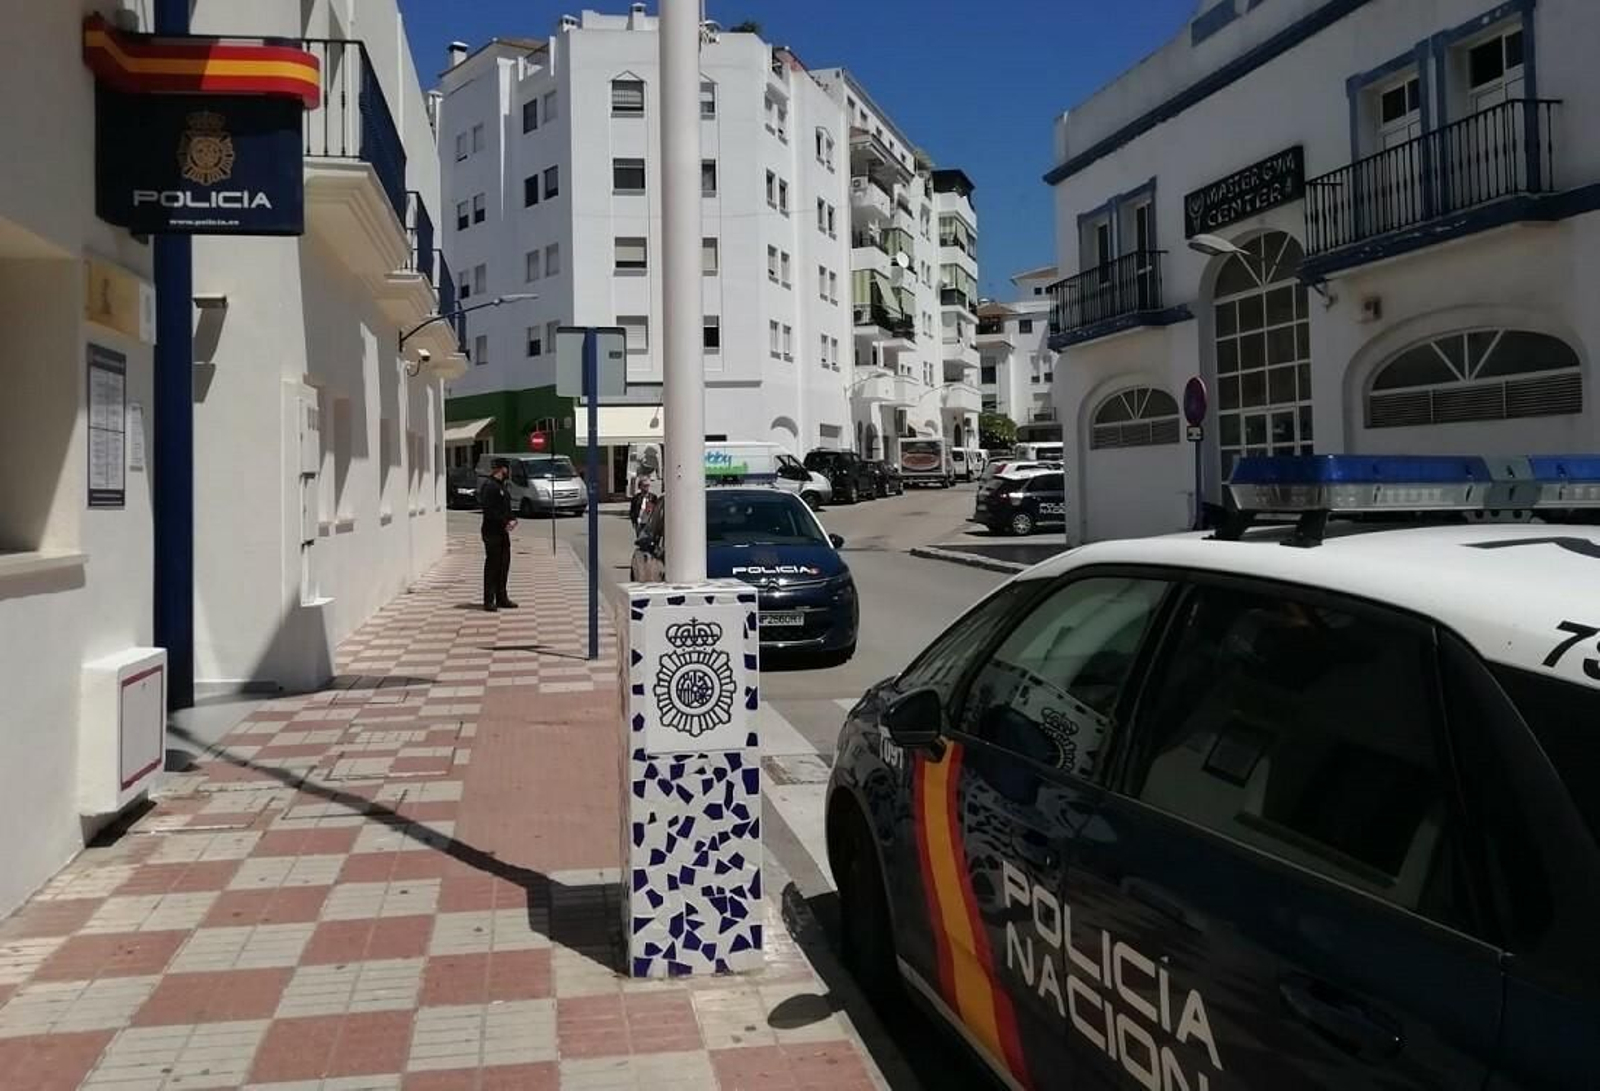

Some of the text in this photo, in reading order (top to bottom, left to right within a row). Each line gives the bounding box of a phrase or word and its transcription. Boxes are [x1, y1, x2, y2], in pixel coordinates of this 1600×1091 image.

[1206, 152, 1295, 206] MASTER GYM
[168, 218, 241, 227] www.policia.es
[1208, 183, 1281, 226] CENTER
